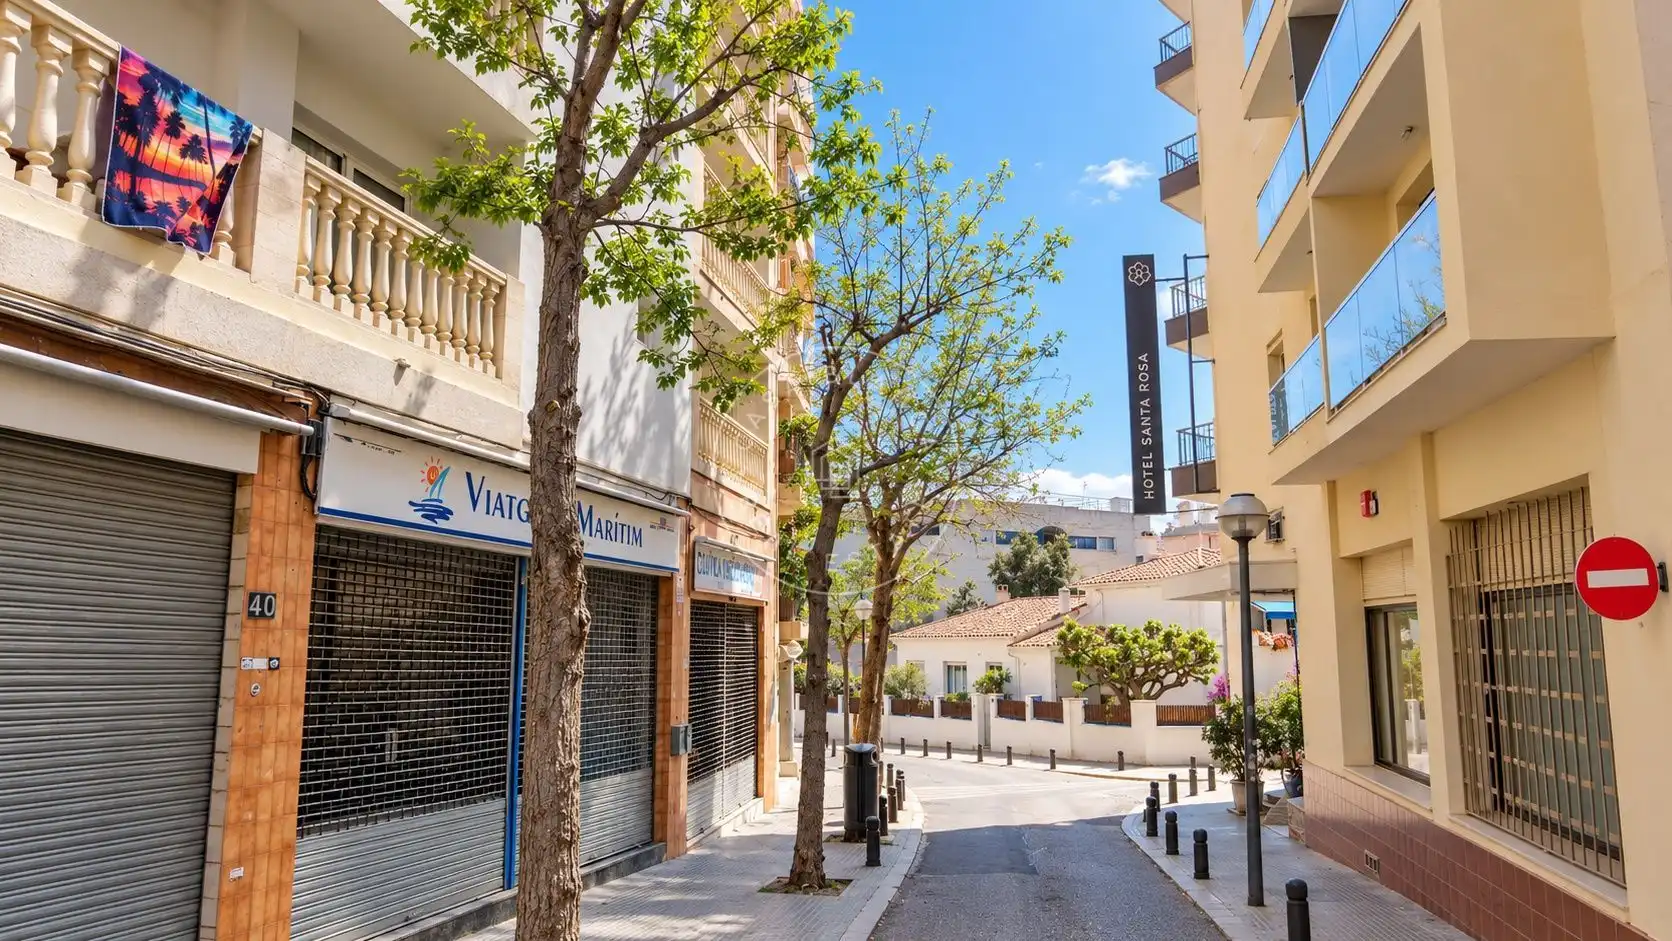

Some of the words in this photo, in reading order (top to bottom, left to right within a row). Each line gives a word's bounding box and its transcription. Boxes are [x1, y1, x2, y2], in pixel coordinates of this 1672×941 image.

[1138, 353, 1150, 392] ROSA
[1140, 398, 1153, 445] SANTA
[466, 471, 530, 523] VIATG
[1142, 452, 1155, 499] HOTEL
[249, 594, 276, 617] 40
